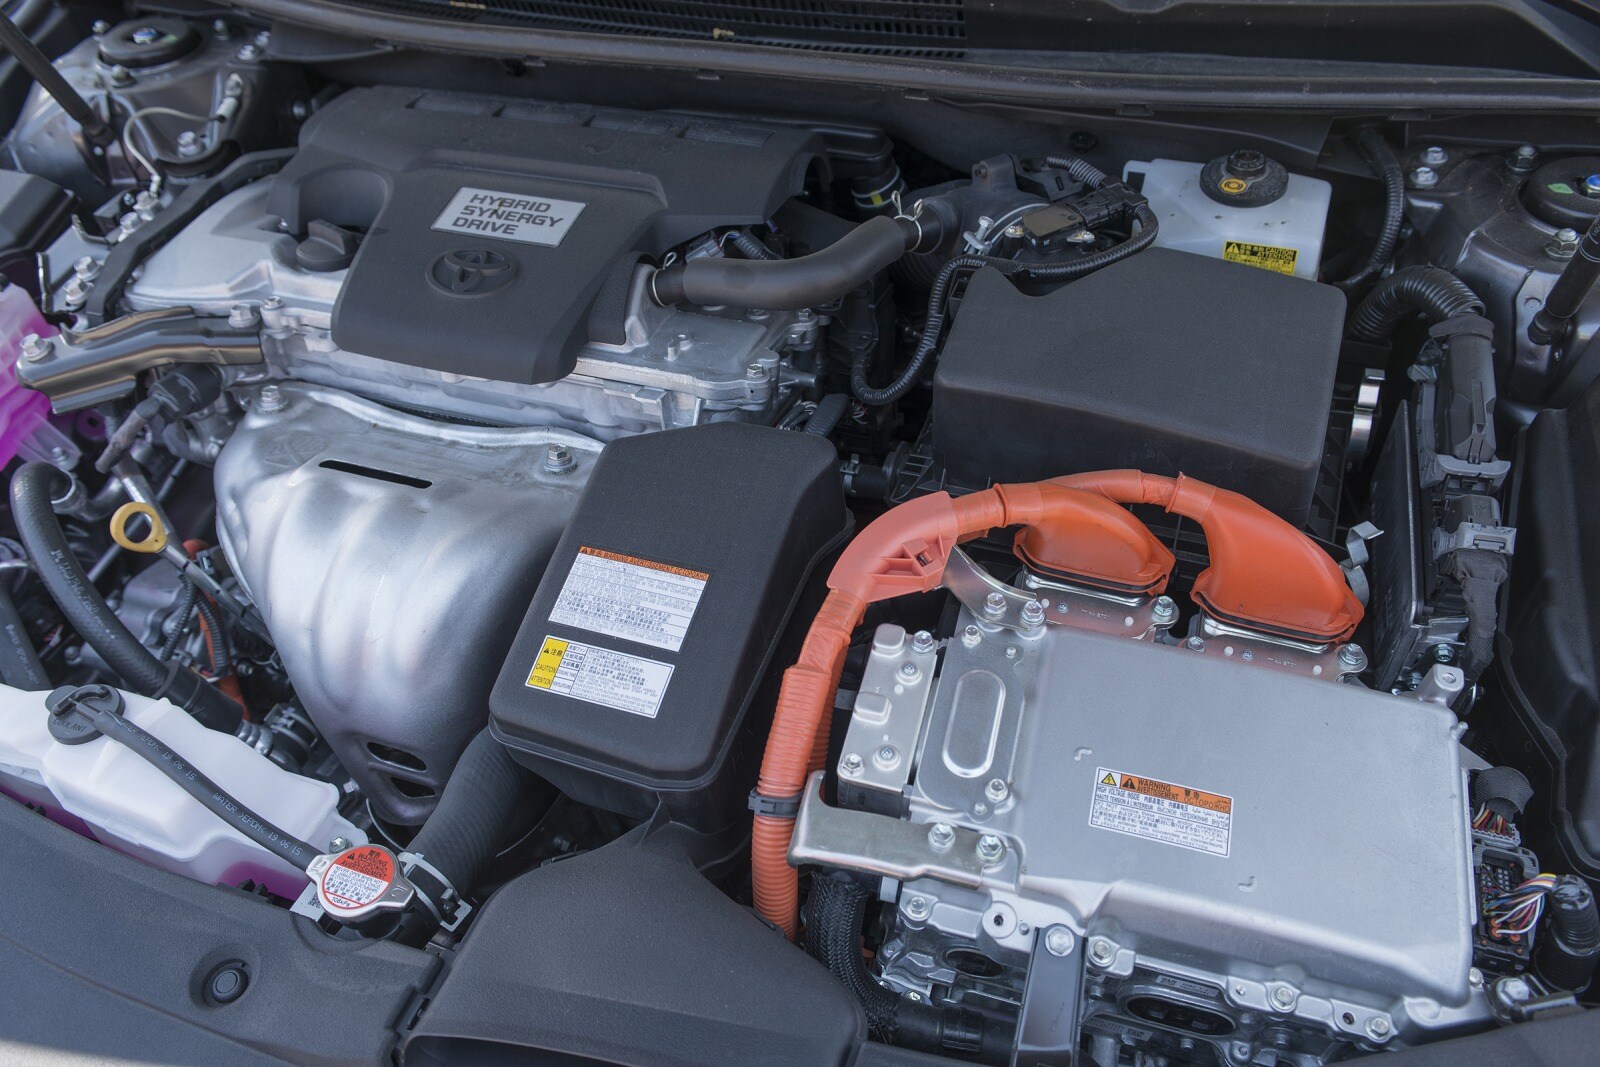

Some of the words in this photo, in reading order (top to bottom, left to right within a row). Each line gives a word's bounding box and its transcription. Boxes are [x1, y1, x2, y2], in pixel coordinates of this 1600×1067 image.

[469, 193, 551, 213] HYBRID
[461, 205, 563, 227] SYNERGY
[452, 217, 519, 234] DRIVE
[1257, 251, 1294, 261] ATTENTION
[1265, 246, 1294, 255] CAUTION
[549, 648, 563, 657] 注意
[534, 663, 557, 673] CAUTION
[529, 674, 551, 685] ATTENTION
[53, 718, 87, 732] COOLANT
[161, 750, 173, 761] 19
[172, 759, 185, 771] 06
[184, 769, 198, 782] 15
[1096, 784, 1106, 792] HIGH
[1108, 787, 1125, 797] VOLTAGE
[1127, 791, 1139, 800] INSIDE
[1136, 784, 1178, 800] AVERTISSEMENT
[1137, 778, 1171, 792] WARNING
[1109, 795, 1126, 804] TENSION
[1183, 795, 1230, 813] ОСТОРОЖНО
[213, 792, 237, 813] WATER
[267, 831, 279, 842] 19
[279, 838, 291, 850] 06
[291, 845, 304, 857] 15
[357, 852, 388, 867] WARNING
[341, 860, 388, 880] AVERTISSEMENT
